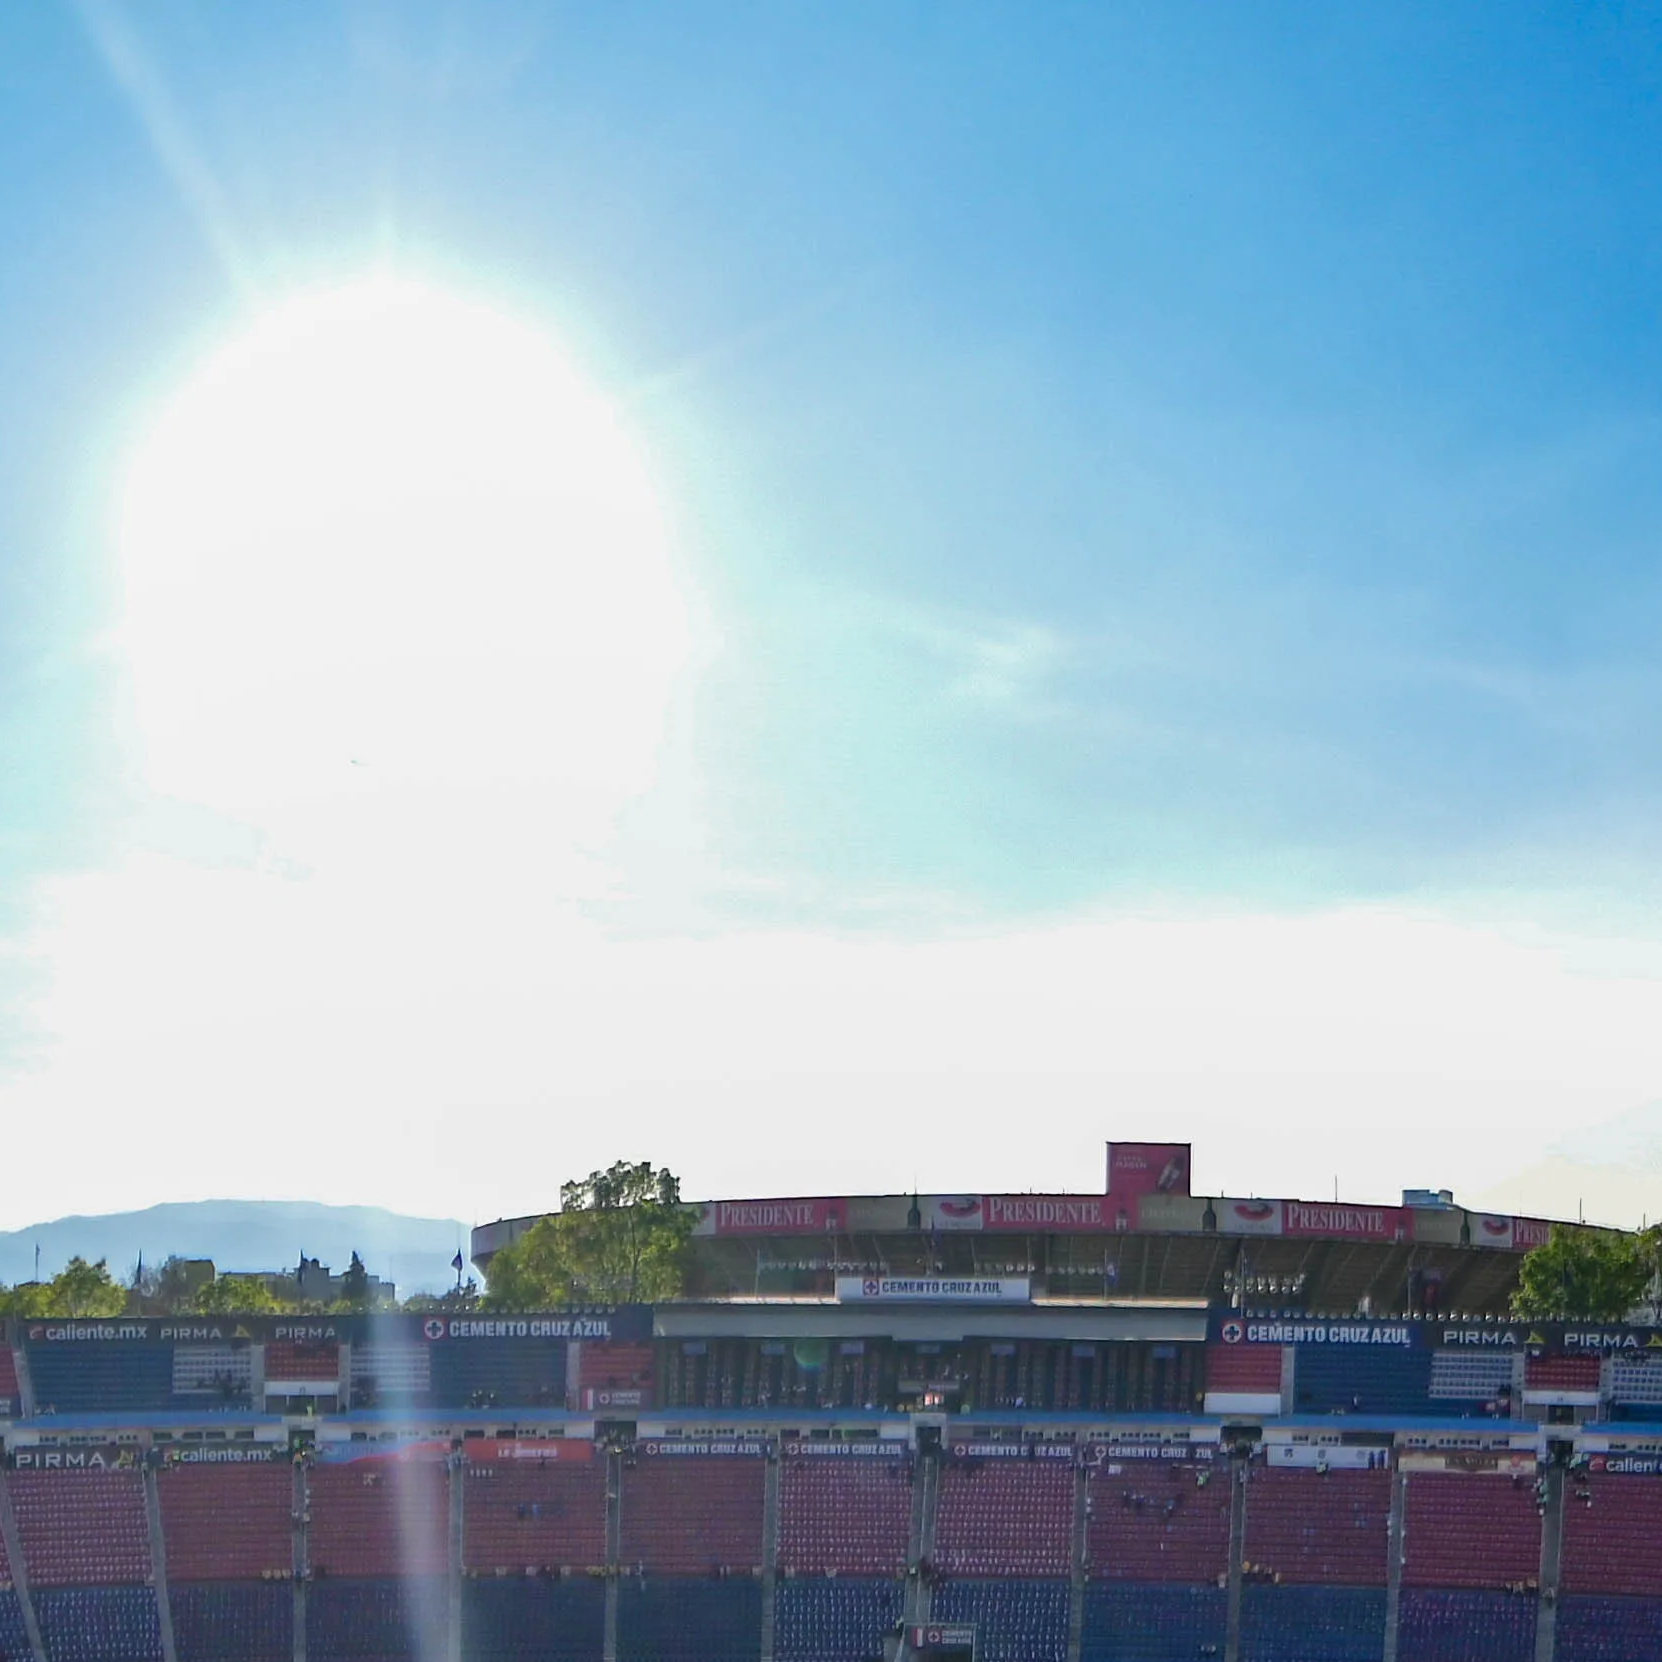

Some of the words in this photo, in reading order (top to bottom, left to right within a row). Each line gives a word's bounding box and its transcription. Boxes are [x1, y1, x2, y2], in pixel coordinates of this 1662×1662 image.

[720, 1202, 814, 1227] PRESIDENTE
[989, 1197, 1102, 1224] PRESIDENTE
[1288, 1203, 1384, 1233] PRESIDENTE
[882, 1280, 939, 1294] CEMENTO
[943, 1281, 971, 1294] CRUZ
[974, 1281, 1002, 1295] AZUL
[45, 1324, 147, 1341] caliente.mx
[160, 1327, 221, 1340] PIRMA
[275, 1326, 336, 1340] PIRMA
[449, 1321, 526, 1337] CEMENTO
[530, 1320, 570, 1337] CRUZ
[573, 1319, 612, 1337] AZUL
[1247, 1324, 1325, 1342] CEMENTO
[1328, 1325, 1369, 1343] CRUZ
[1372, 1326, 1411, 1345] AZUL
[1443, 1330, 1516, 1345] PIRMA
[1564, 1333, 1638, 1347] PIRMA
[181, 1447, 271, 1463] caliente.mx
[1020, 1445, 1046, 1457] CUZ
[16, 1452, 105, 1469] PIRMA
